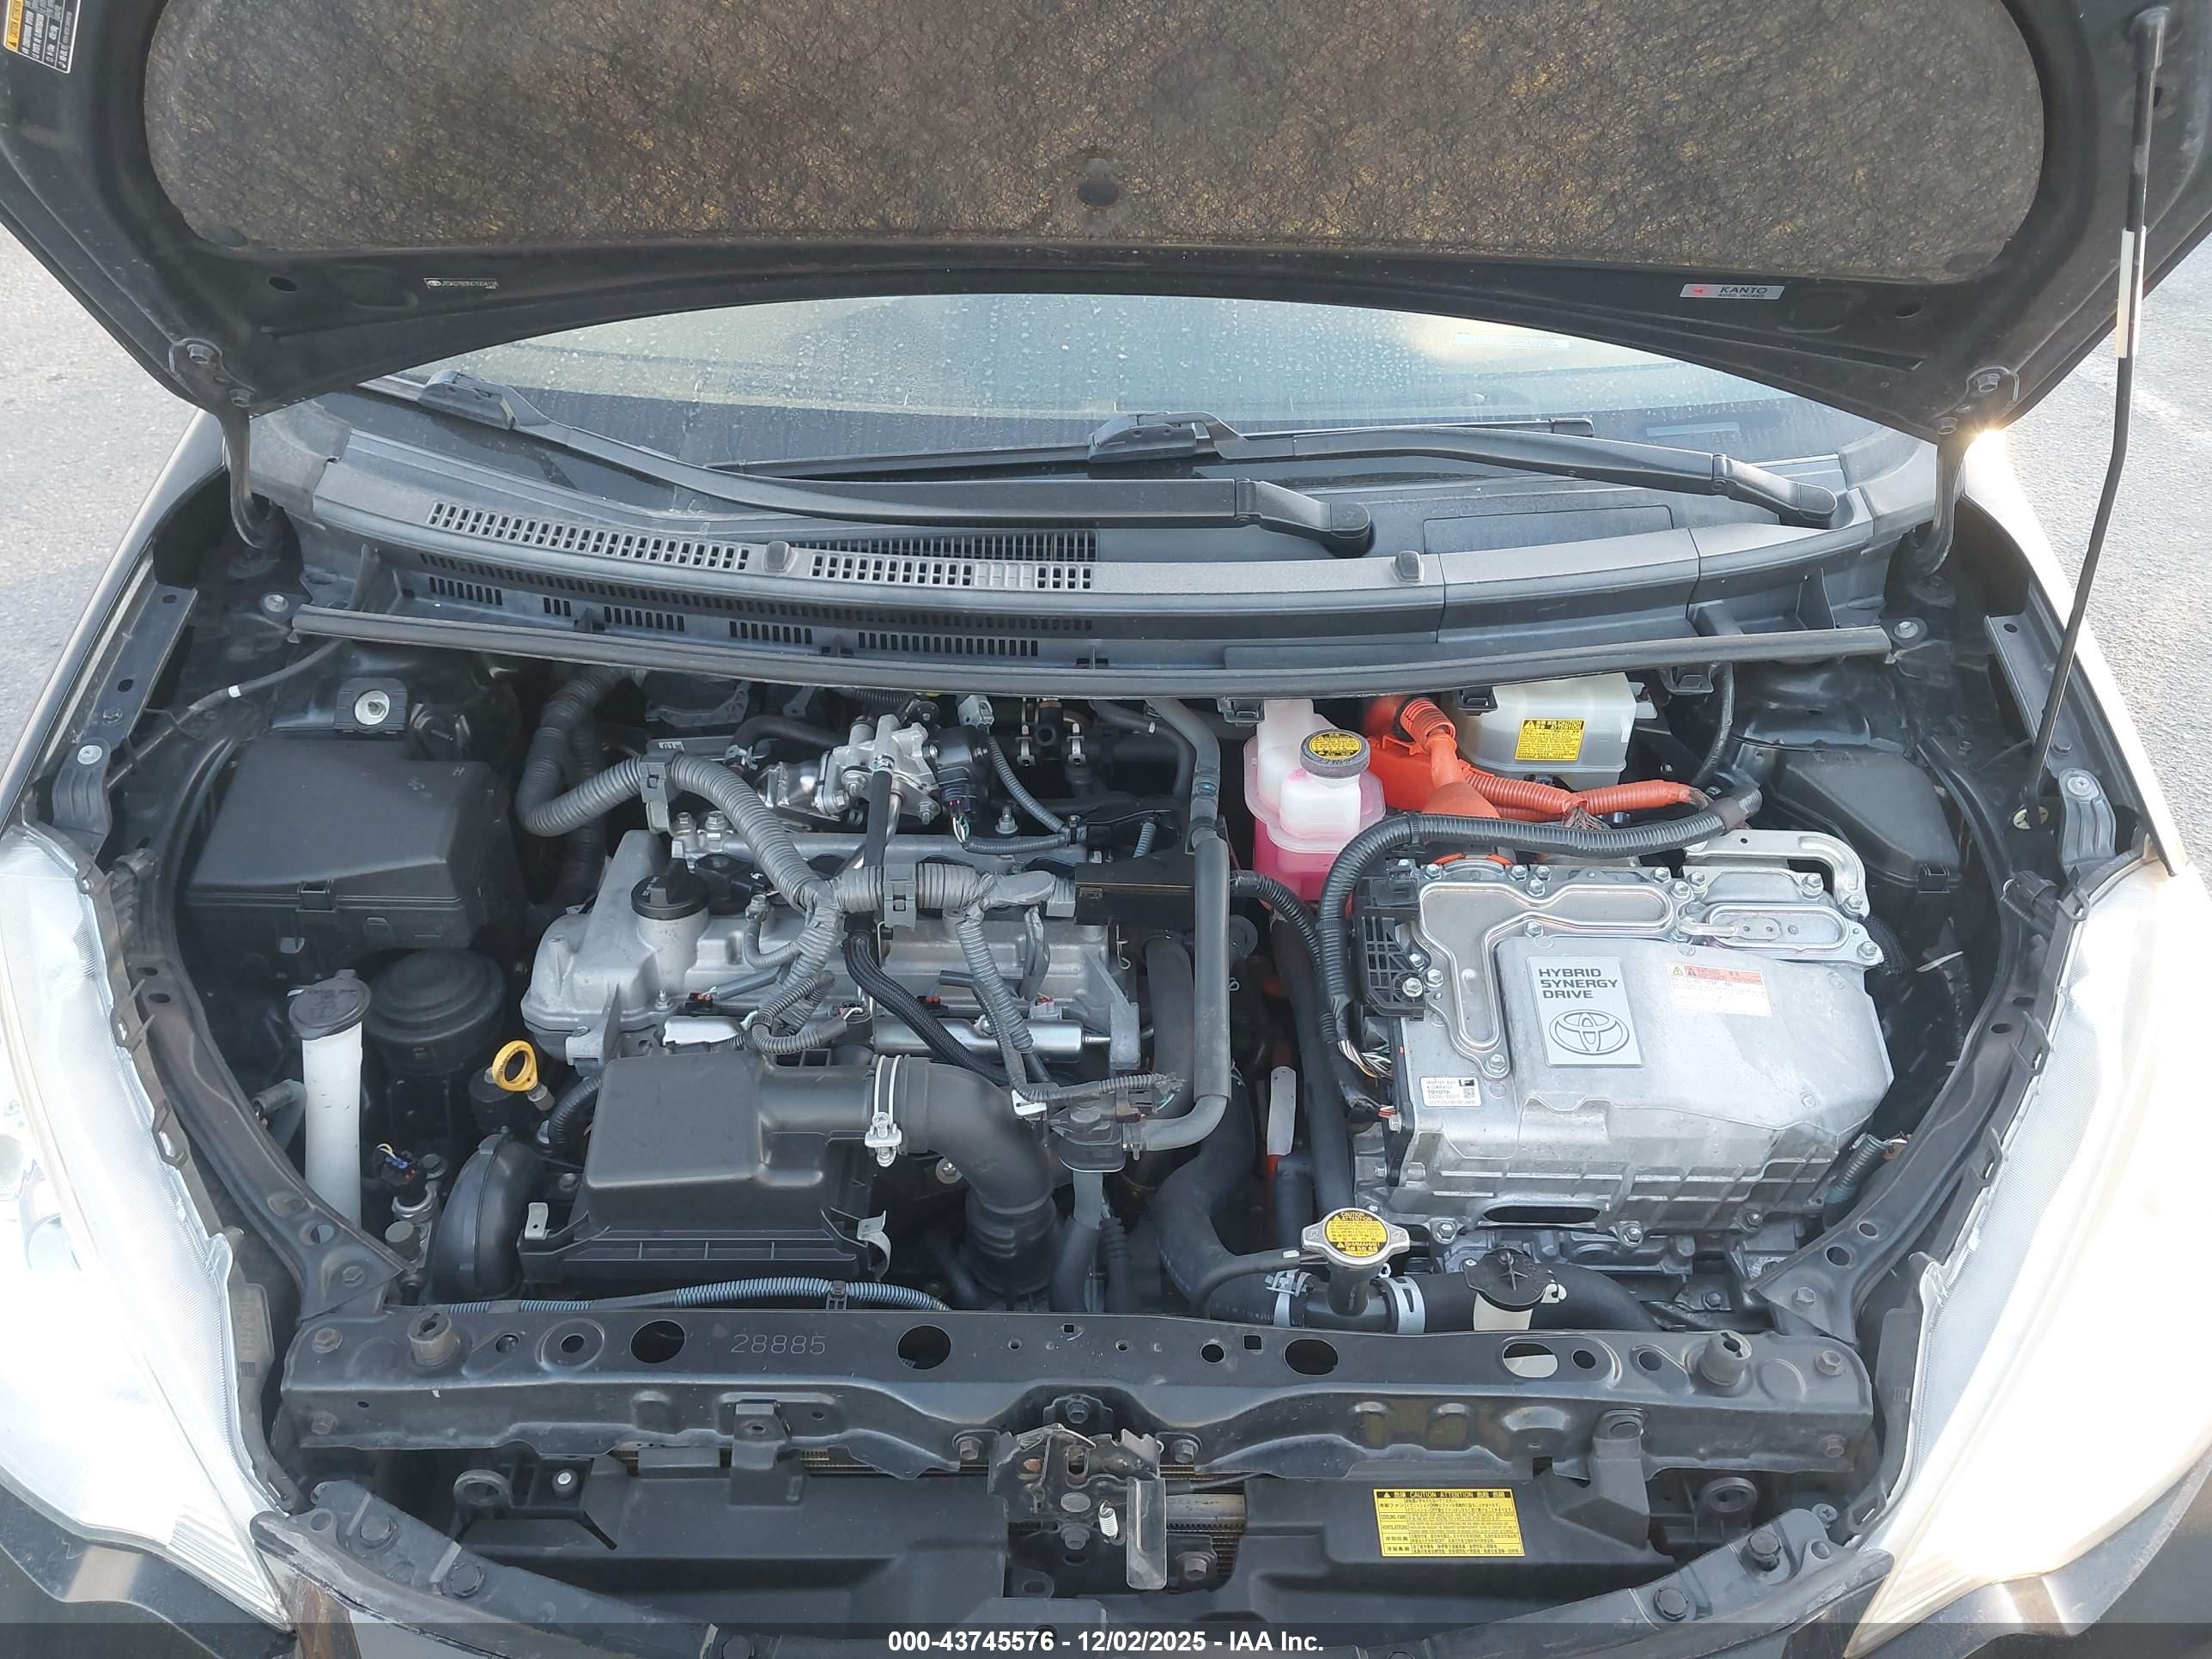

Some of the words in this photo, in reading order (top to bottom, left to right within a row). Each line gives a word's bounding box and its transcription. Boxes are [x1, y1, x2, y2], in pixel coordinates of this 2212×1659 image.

[1538, 968, 1601, 977] HYBRID
[1540, 979, 1619, 988] SYNERGY
[1542, 990, 1595, 999] DRIVE
[730, 1334, 827, 1354] 28885
